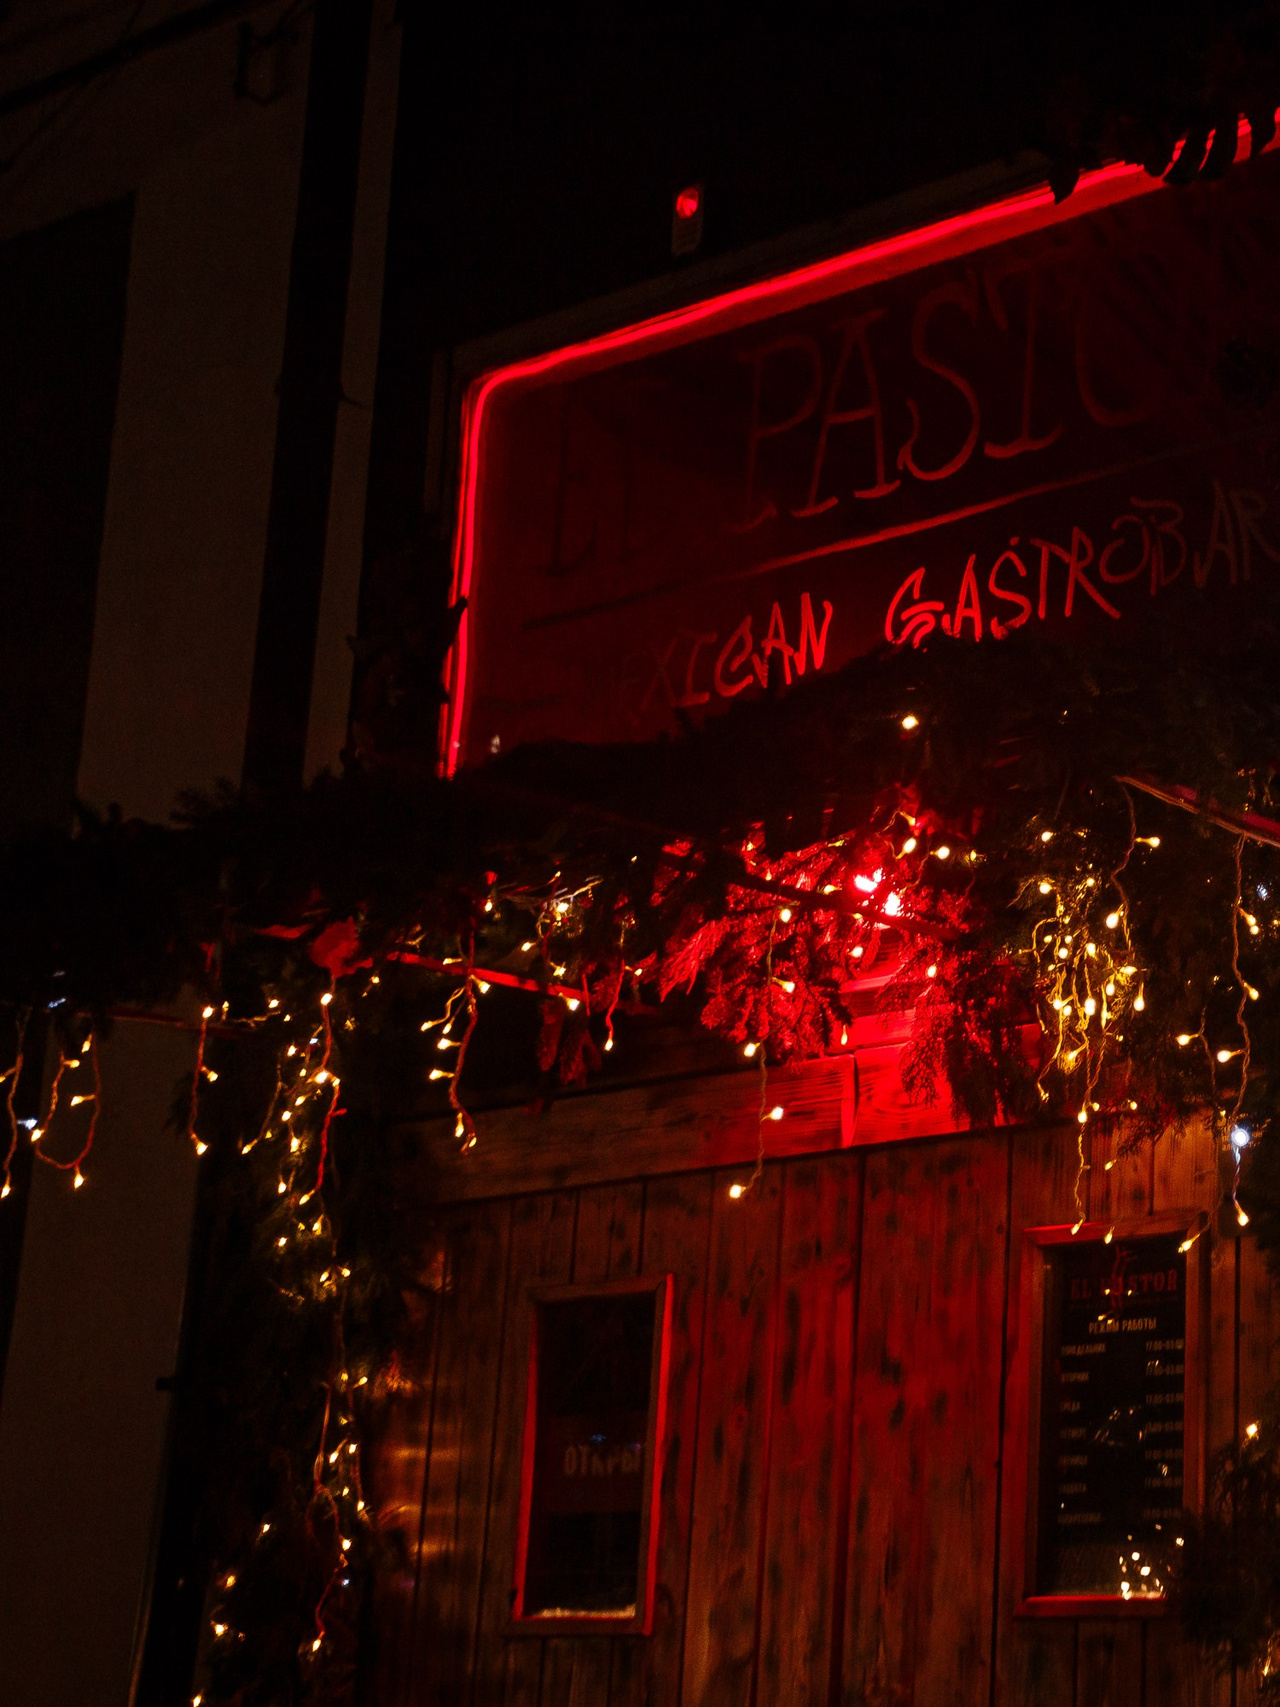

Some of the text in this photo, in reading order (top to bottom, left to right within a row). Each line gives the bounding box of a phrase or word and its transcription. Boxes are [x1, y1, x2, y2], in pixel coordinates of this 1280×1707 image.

[730, 245, 1195, 533] PASTO
[596, 592, 836, 714] EXICAN
[1121, 1316, 1157, 1332] РАБОТЫ
